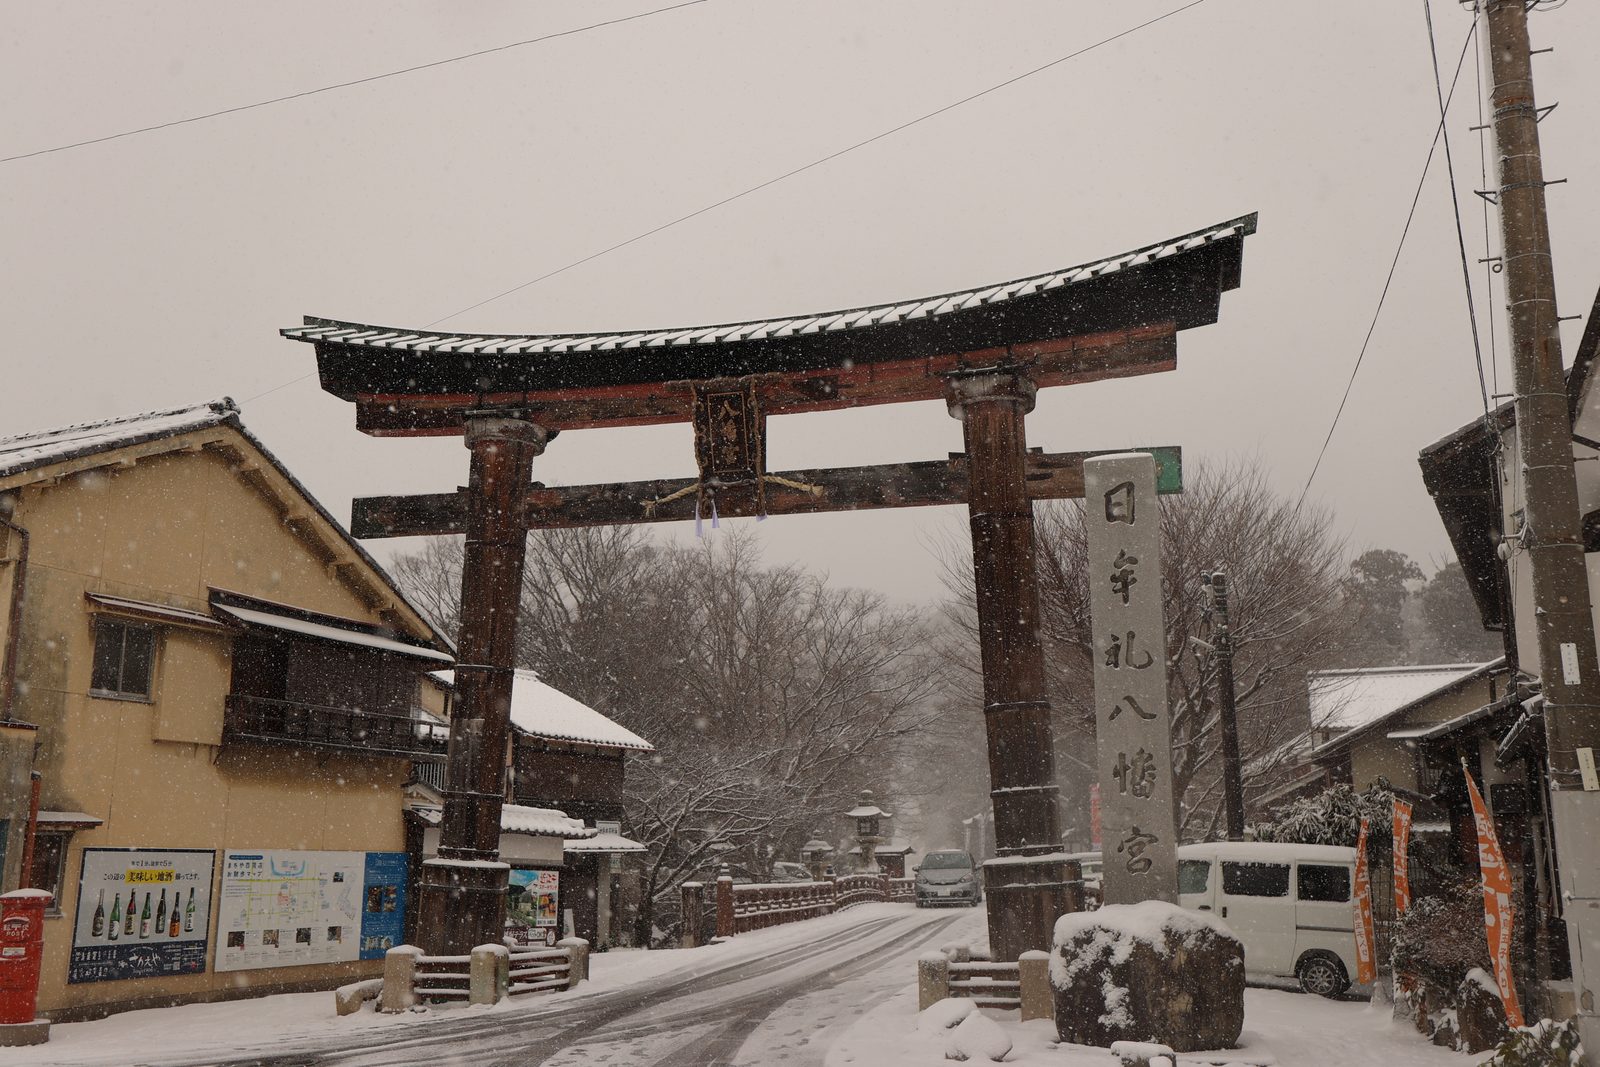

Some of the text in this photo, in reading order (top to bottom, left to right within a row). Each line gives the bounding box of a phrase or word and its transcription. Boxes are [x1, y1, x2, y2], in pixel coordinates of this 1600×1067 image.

[1103, 480, 1159, 876] 日牟礼八幡宮
